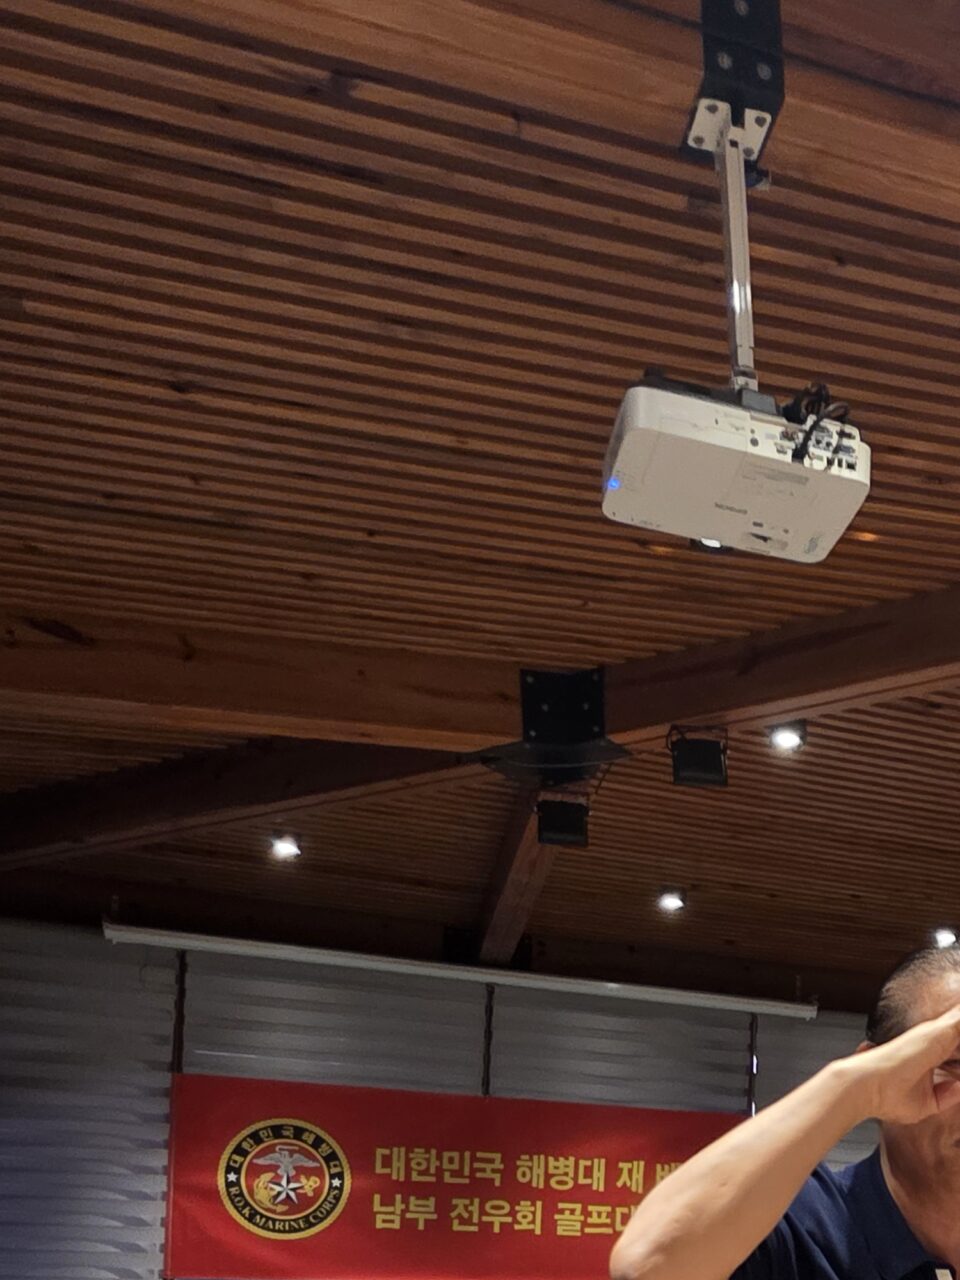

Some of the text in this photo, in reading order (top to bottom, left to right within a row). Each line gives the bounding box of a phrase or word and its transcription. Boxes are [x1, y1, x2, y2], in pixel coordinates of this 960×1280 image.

[375, 1147, 504, 1187] 대한민국
[516, 1154, 606, 1192] 해병대
[616, 1160, 645, 1194] 재
[252, 1214, 309, 1231] MARINE
[309, 1188, 340, 1224] CORPS
[373, 1193, 438, 1230] 남부
[450, 1197, 542, 1235] 전우회
